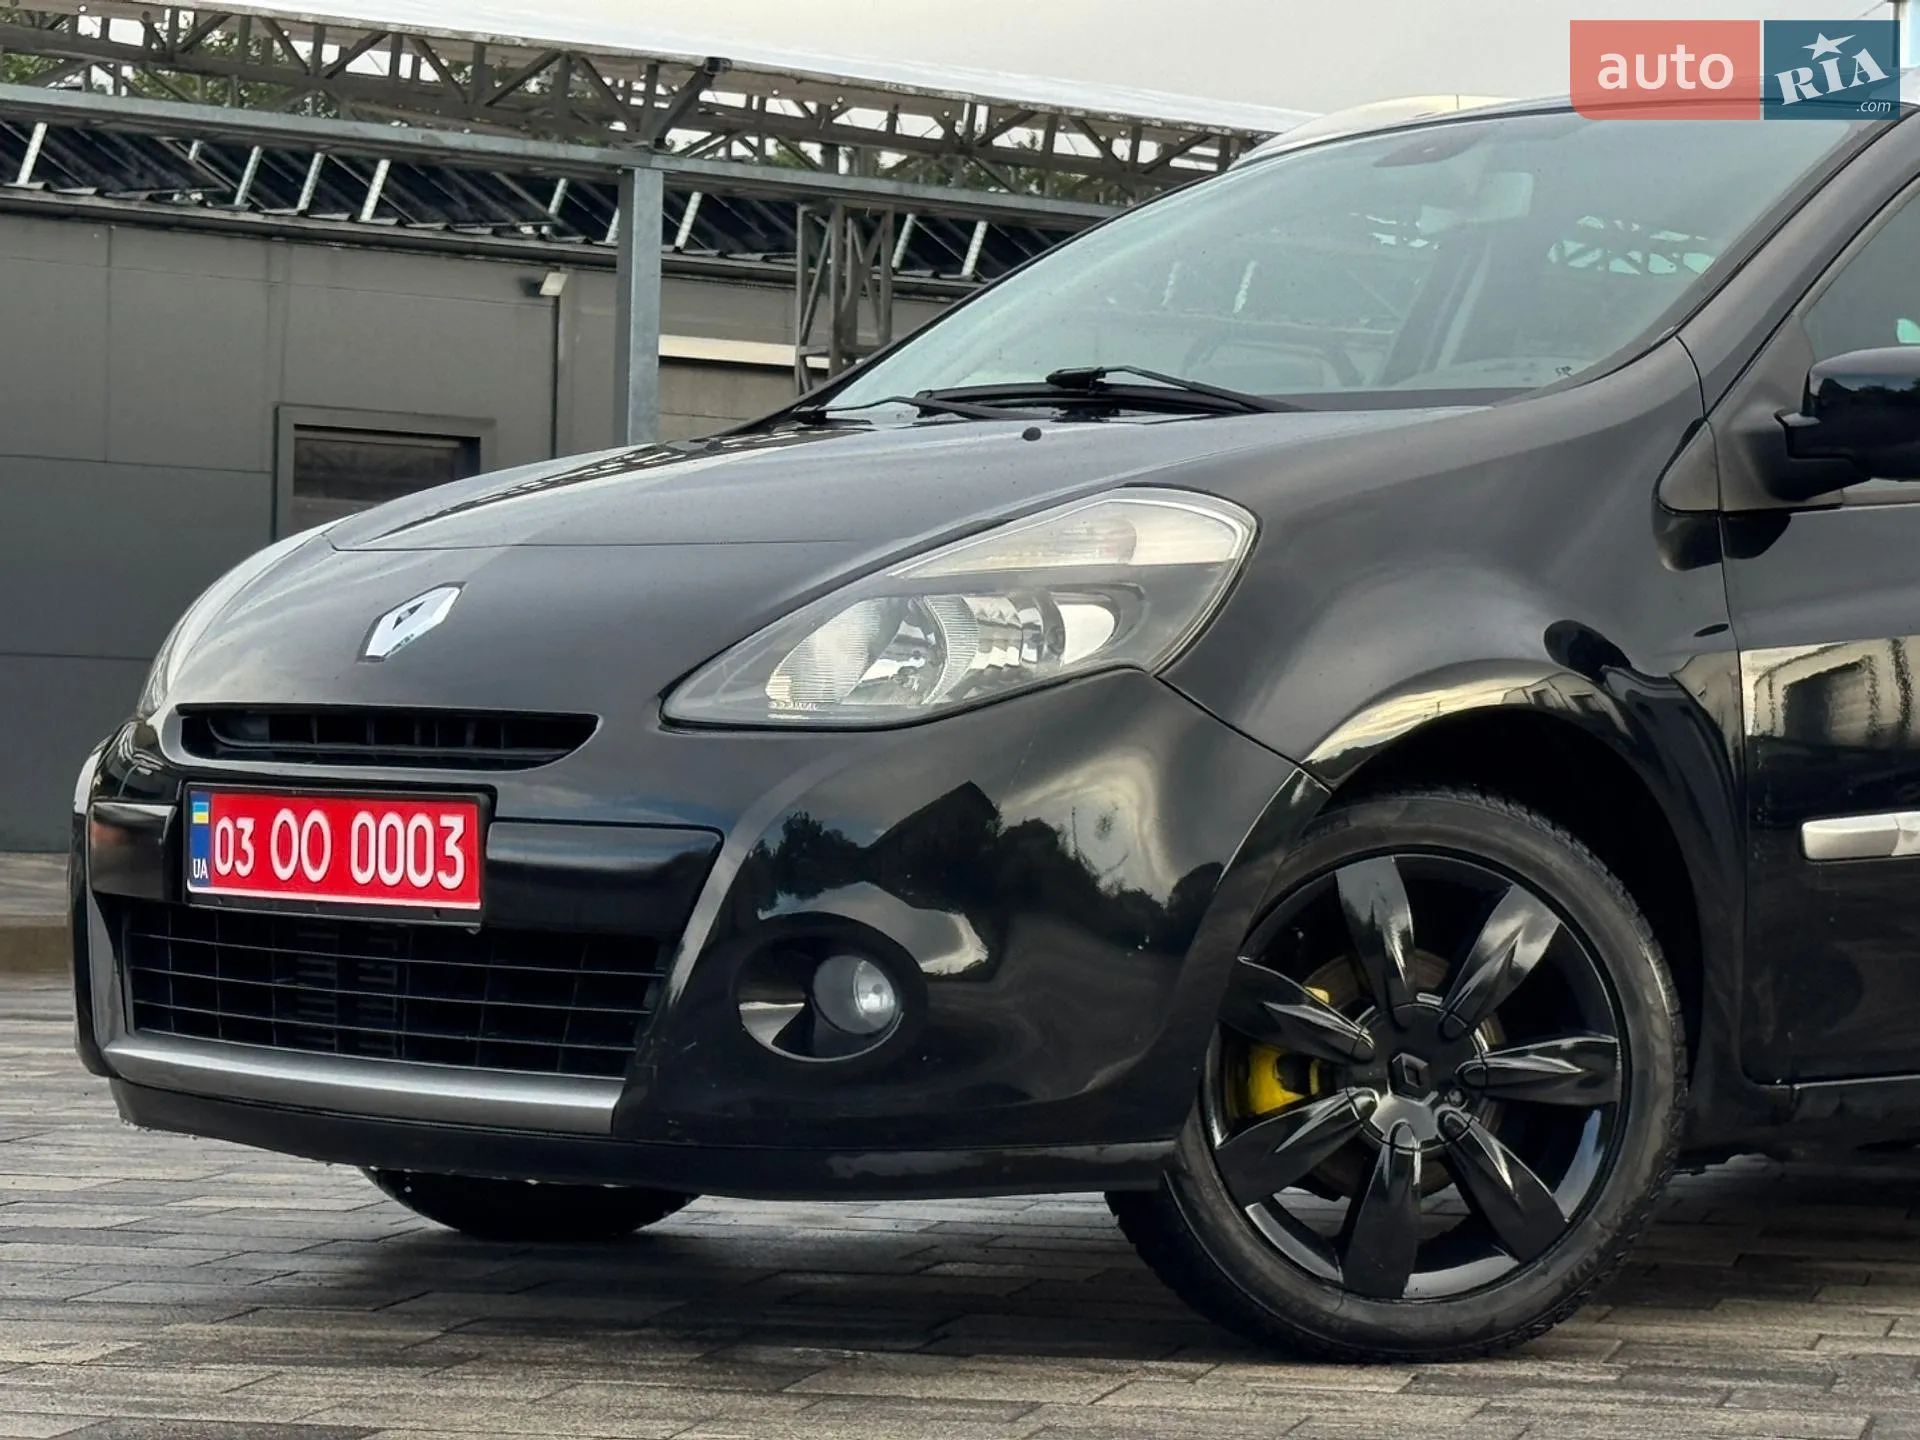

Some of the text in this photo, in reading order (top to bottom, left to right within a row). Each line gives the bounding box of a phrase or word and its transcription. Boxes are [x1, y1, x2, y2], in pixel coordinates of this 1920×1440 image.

[193, 858, 208, 879] UA
[214, 816, 255, 877] 03
[350, 811, 465, 890] 0003
